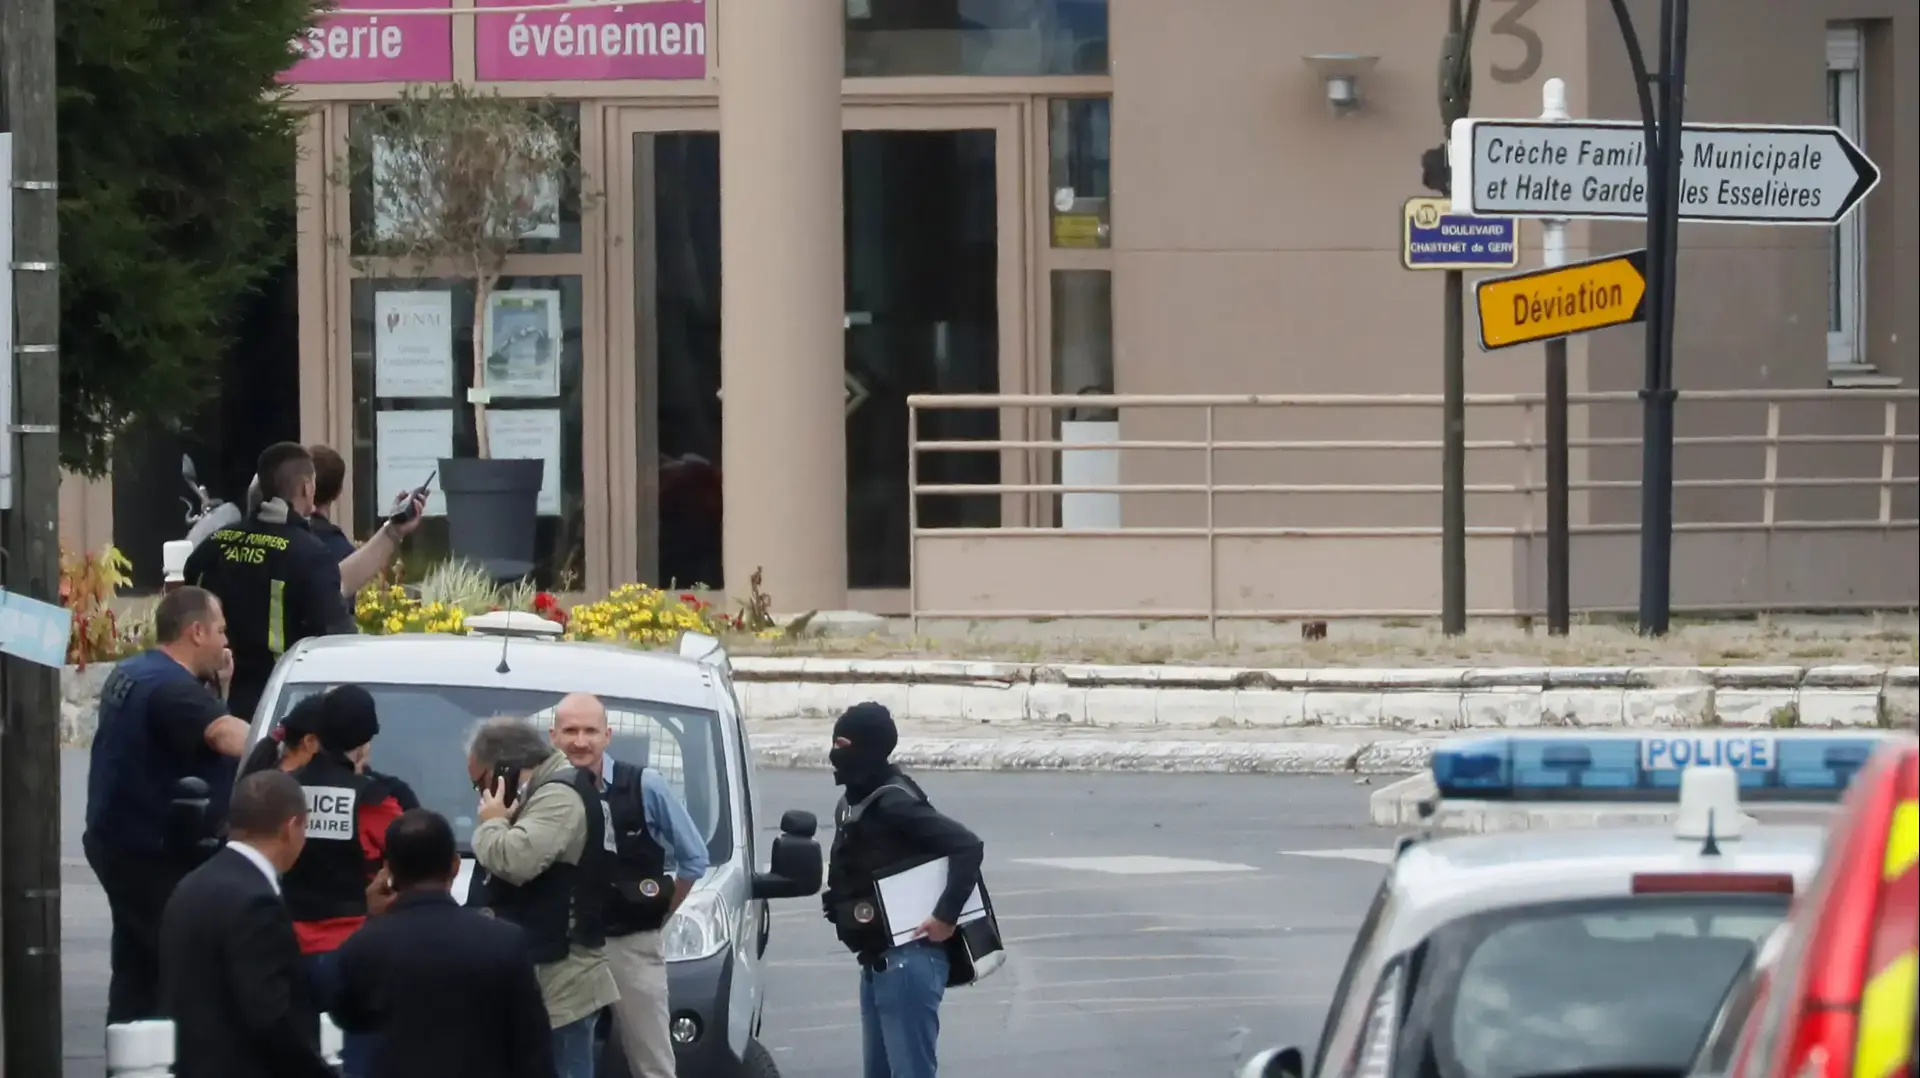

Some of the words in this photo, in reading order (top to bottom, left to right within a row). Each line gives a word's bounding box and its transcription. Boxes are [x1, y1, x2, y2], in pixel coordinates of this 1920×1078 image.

[1489, 0, 1543, 84] 3
[1488, 138, 1568, 166] Crèche
[1693, 142, 1821, 176] Municipale
[1487, 177, 1507, 200] et
[1516, 174, 1572, 200] Halte
[1582, 176, 1648, 203] Garde
[1680, 178, 1708, 205] les
[1717, 179, 1821, 207] Esselières
[1441, 225, 1504, 236] BOULEVARD
[1410, 242, 1467, 253] CHASTENET
[1471, 243, 1484, 253] de
[1513, 280, 1622, 327] Déviation
[1649, 738, 1767, 767] POLICE
